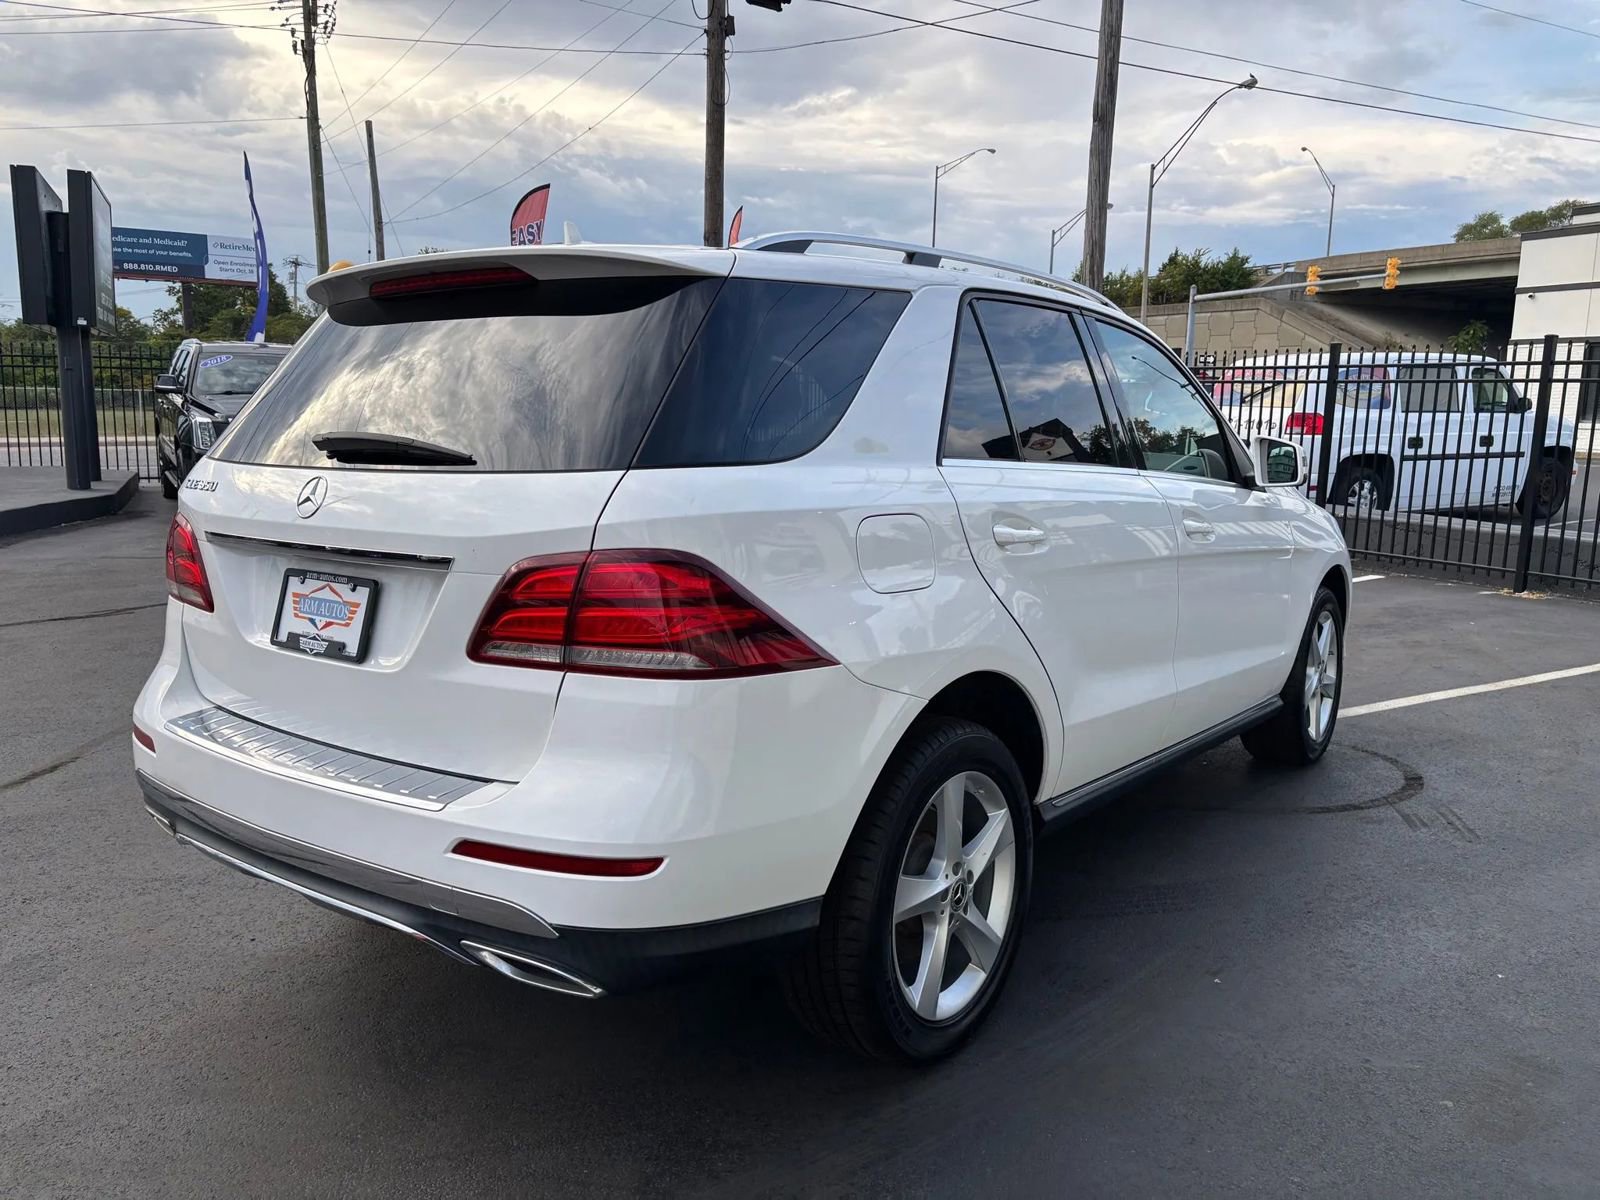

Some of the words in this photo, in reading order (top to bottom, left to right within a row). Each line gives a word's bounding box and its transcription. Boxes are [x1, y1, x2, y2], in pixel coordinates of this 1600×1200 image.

[511, 219, 543, 246] EASY
[112, 235, 138, 243] edicare
[153, 238, 188, 247] Medicaid?
[123, 262, 179, 273] 888.810.RMED
[230, 260, 256, 269] Enrollmen
[306, 572, 348, 583] arm-autos.com
[299, 598, 318, 613] ARM
[319, 602, 350, 618] AUTOS
